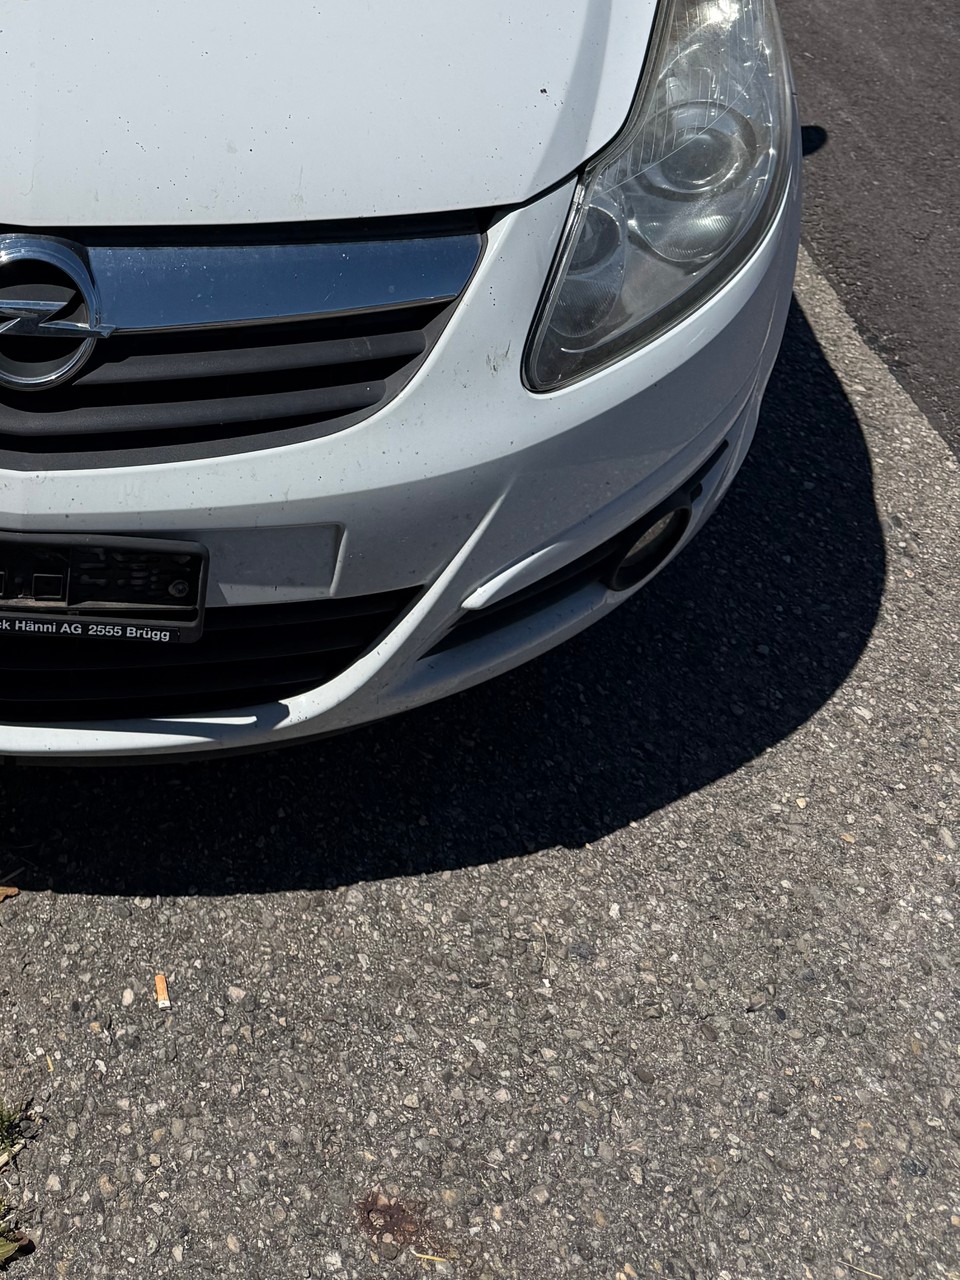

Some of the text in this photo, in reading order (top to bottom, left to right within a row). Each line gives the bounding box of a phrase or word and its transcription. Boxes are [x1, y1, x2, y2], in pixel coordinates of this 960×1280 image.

[15, 620, 57, 633] Hänni
[60, 623, 82, 634] AG
[88, 624, 122, 636] 2555
[126, 626, 170, 642] Brügg
